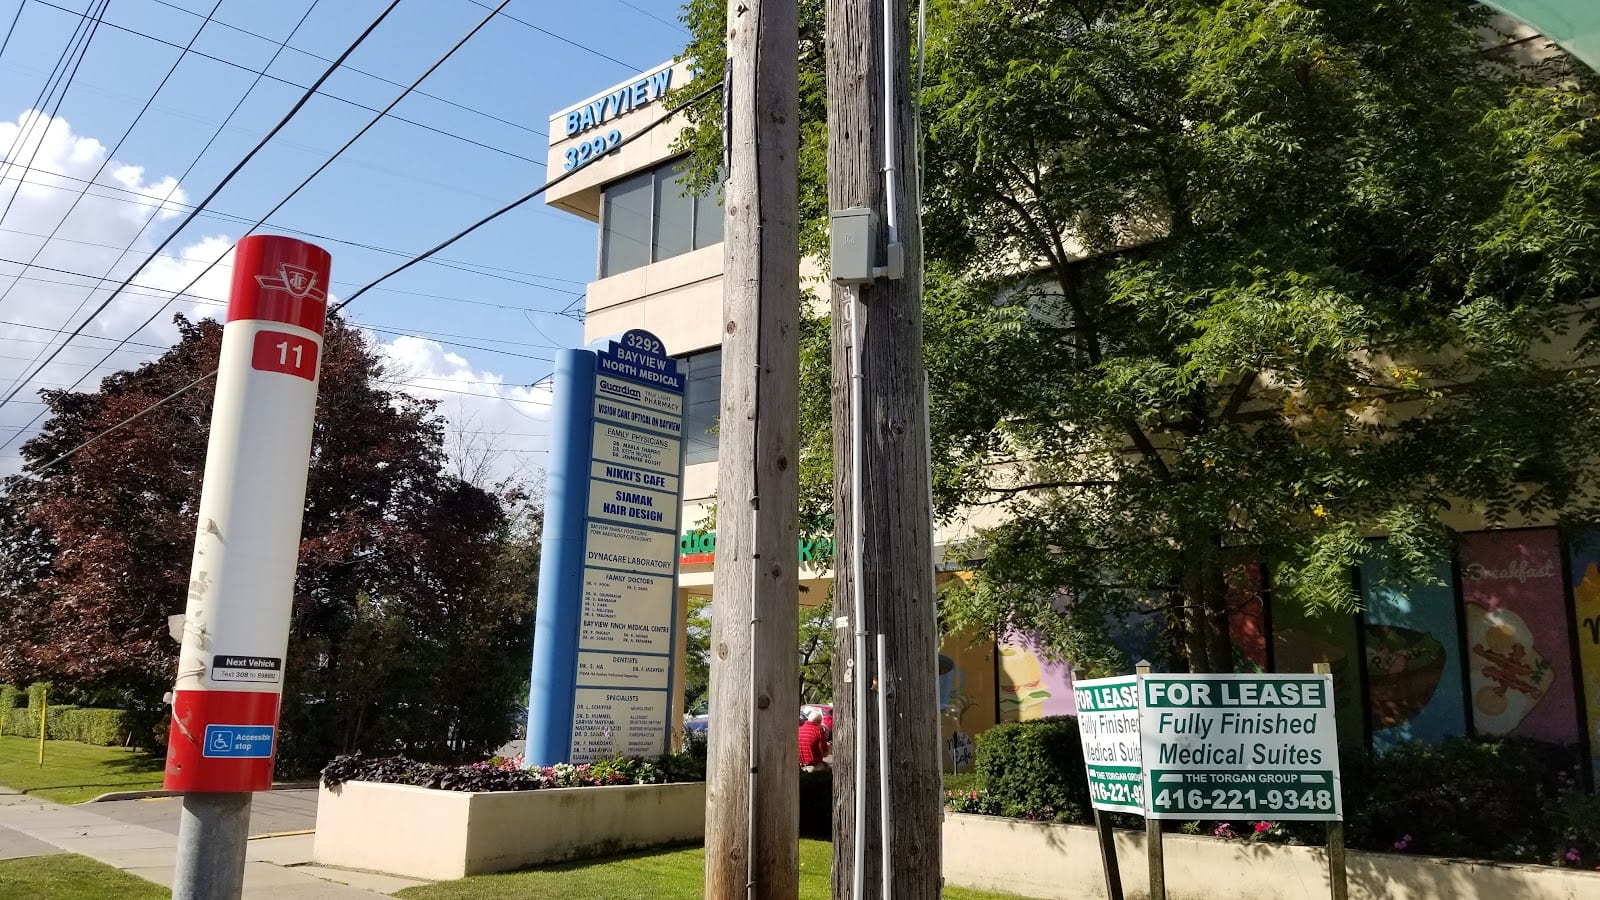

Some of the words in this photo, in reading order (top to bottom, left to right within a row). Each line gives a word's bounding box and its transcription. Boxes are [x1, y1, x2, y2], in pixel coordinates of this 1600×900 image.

[566, 67, 673, 137] BAYVIEW
[564, 130, 622, 170] 3292
[628, 334, 660, 354] 3292
[276, 342, 302, 368] 11
[618, 348, 666, 371] BAYVIEW
[602, 358, 637, 376] NORTH
[639, 369, 679, 388] MEDICAL
[600, 380, 640, 398] Guardian
[644, 397, 679, 410] PHARMACY
[598, 404, 616, 416] VISION
[617, 407, 630, 418] CARE
[631, 411, 651, 424] OPTICAL
[652, 417, 659, 427] ON
[660, 420, 680, 432] BAYVIEW
[608, 428, 630, 438] FAMILY
[632, 434, 669, 448] PHYSICIANS
[606, 466, 642, 482] NIKKI'S
[644, 474, 666, 487] CAFE
[616, 490, 653, 506] SIAMAK
[603, 502, 626, 516] HAIR
[628, 508, 663, 522] DESIGN
[588, 551, 626, 564] DYNACARE
[628, 557, 672, 569] LABORATORY
[606, 574, 626, 582] FAMILY
[628, 576, 654, 585] DOCTORS
[1468, 560, 1555, 584] Breakfast
[584, 620, 608, 628] BAYVIEW
[610, 622, 626, 630] FINCH
[627, 624, 650, 632] MEDICAL
[226, 658, 246, 666] Next
[248, 659, 275, 668] Vehicle
[613, 656, 638, 664] DENTISTS
[606, 694, 639, 702] SPECIALISTS
[1076, 689, 1095, 710] FOR
[1094, 686, 1138, 709] LEASE
[1148, 683, 1211, 706] FOR
[1221, 683, 1320, 706] LEASE
[1081, 716, 1097, 740] Fully
[1159, 712, 1216, 739] Fully
[1220, 713, 1317, 735] Finished
[1085, 742, 1117, 762] Medical
[1159, 742, 1244, 765] Medical
[1252, 744, 1322, 766] Suites
[1186, 774, 1207, 783] THE
[1208, 774, 1258, 783] TORGAN
[1260, 774, 1298, 784] GROUP
[1155, 788, 1332, 810] 416-221-9348
